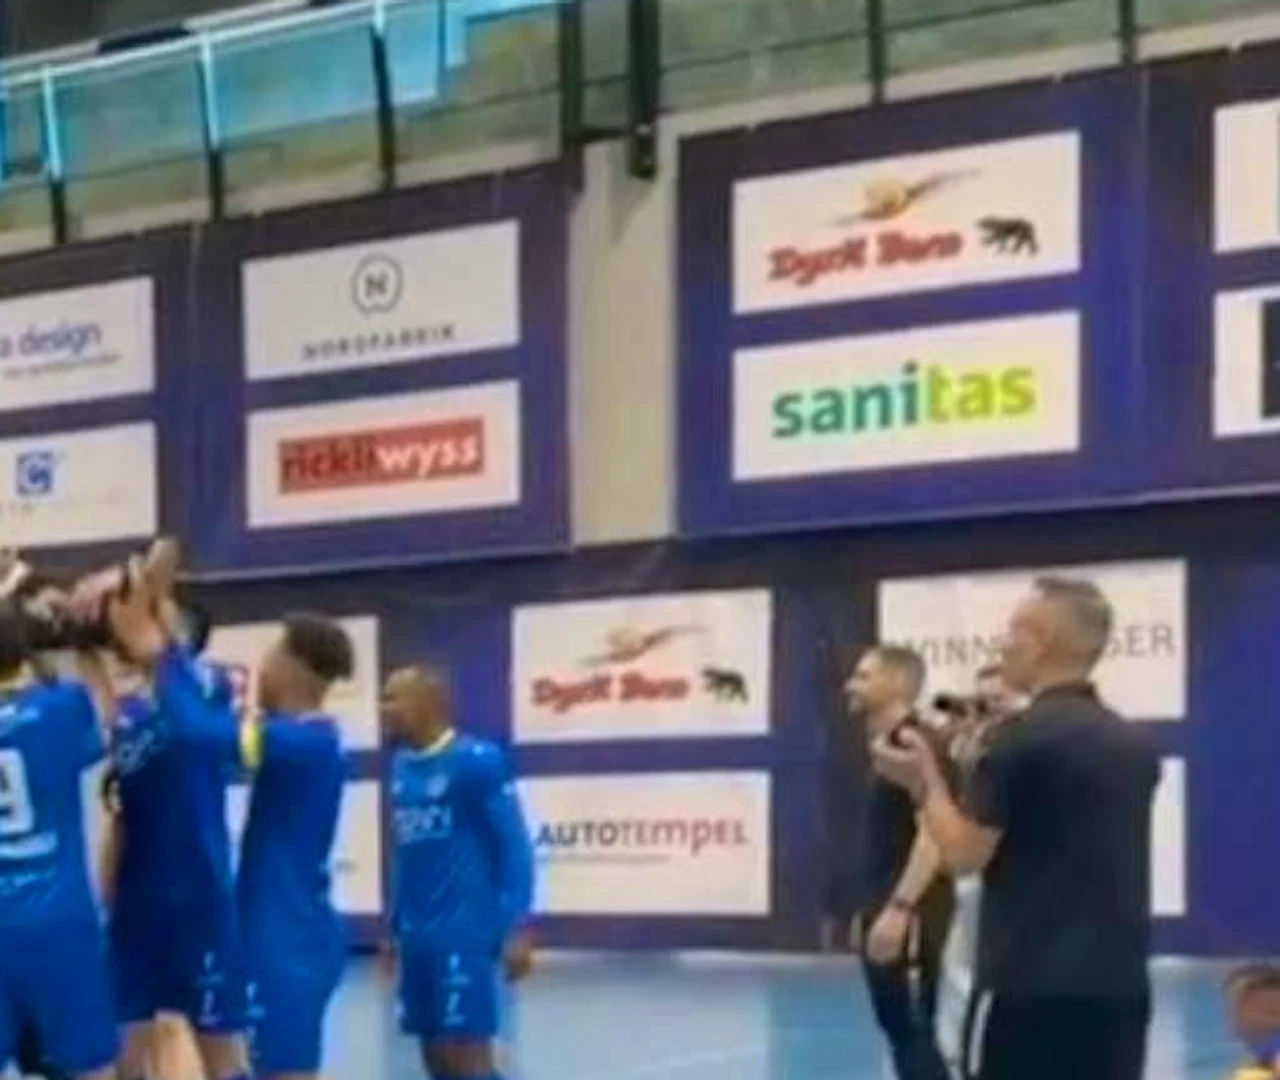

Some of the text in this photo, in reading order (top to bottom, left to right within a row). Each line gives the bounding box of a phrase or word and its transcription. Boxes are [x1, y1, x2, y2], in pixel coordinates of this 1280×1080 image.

[19, 320, 101, 358] design
[303, 323, 456, 361] NORDFABRIK
[772, 362, 1036, 440] sanitas
